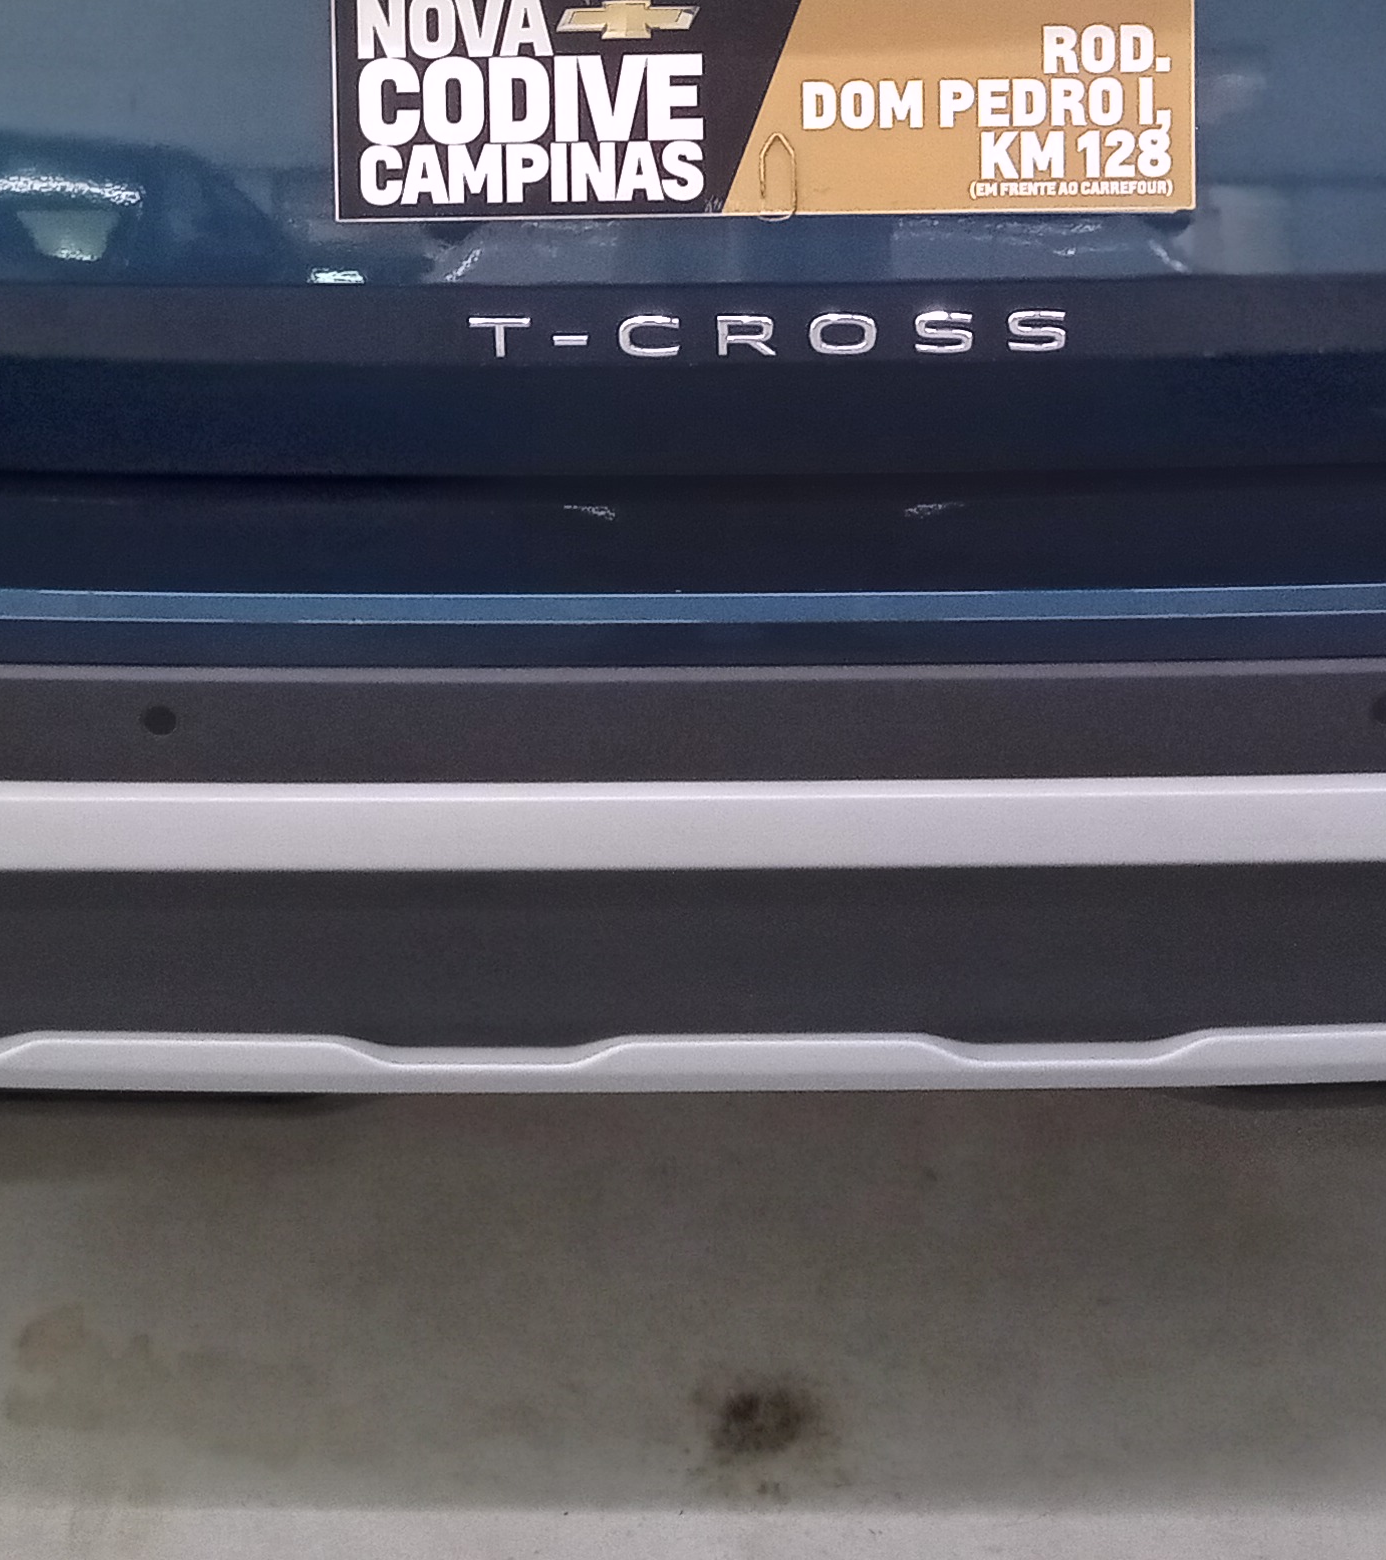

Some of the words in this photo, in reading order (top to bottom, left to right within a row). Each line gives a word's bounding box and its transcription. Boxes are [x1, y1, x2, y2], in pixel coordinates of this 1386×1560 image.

[1041, 24, 1172, 74] ROD.
[358, 53, 704, 146] CODIVE
[801, 79, 924, 130] DOM
[939, 77, 1124, 128] PEDRO
[360, 140, 705, 206] CAMPINAS
[980, 130, 1065, 179] KM
[1076, 129, 1172, 178] 128
[969, 181, 998, 199] (EM
[1000, 181, 1056, 197] FRENTE
[1058, 182, 1078, 196] AO
[1080, 179, 1173, 197] CARREFOUR)
[468, 310, 1067, 359] T-CROSS
